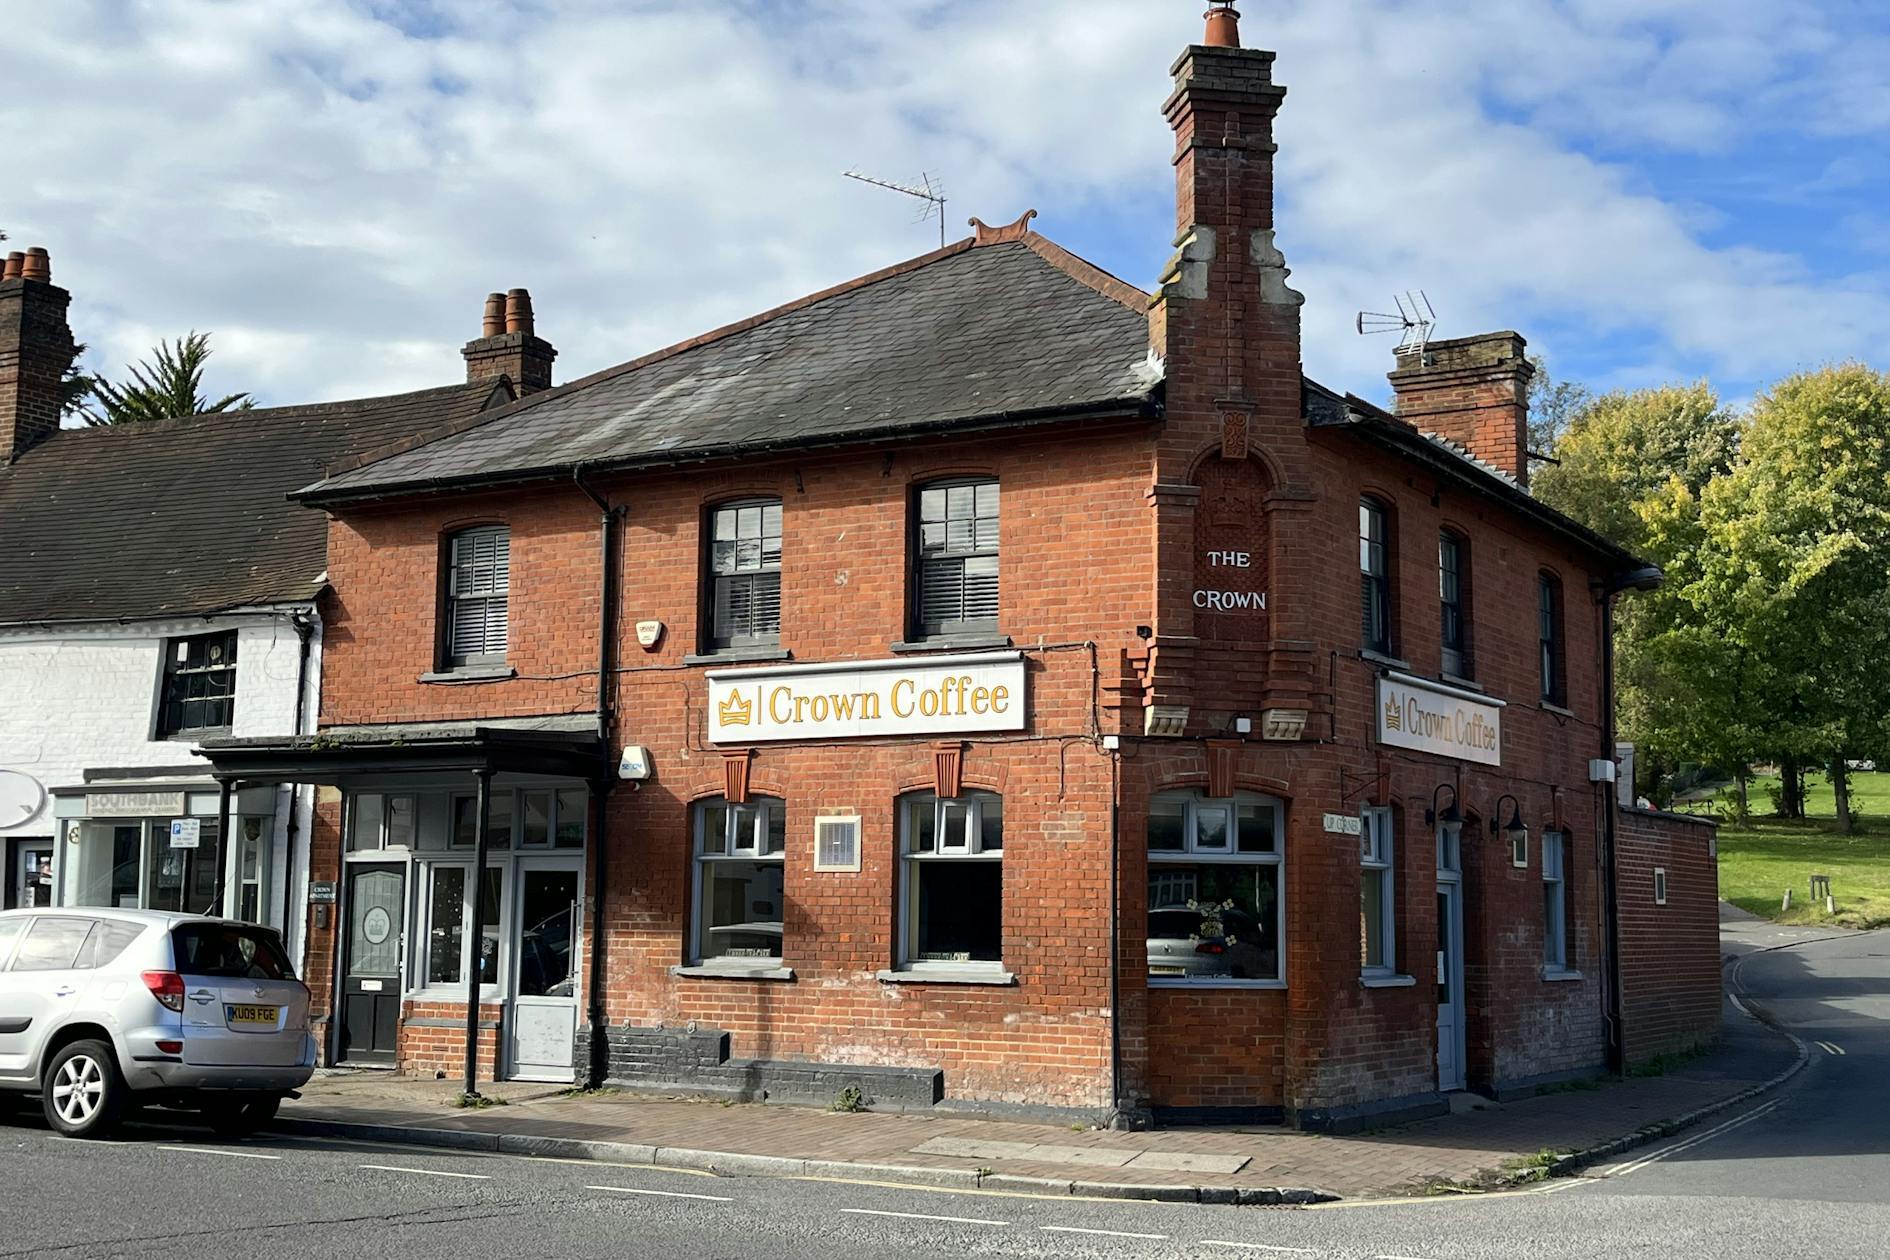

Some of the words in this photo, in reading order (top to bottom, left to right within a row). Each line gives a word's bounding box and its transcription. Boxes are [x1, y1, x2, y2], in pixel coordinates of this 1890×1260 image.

[1206, 550, 1251, 567] THE
[1192, 590, 1266, 611] CROWN
[769, 685, 881, 724] Crown
[890, 676, 1009, 719] Coffee
[1407, 697, 1453, 742] Crown
[1455, 708, 1496, 751] Coffee
[91, 793, 179, 807] SOUTHBANK
[232, 1007, 256, 1020] KU09
[257, 1008, 275, 1021] FGE
